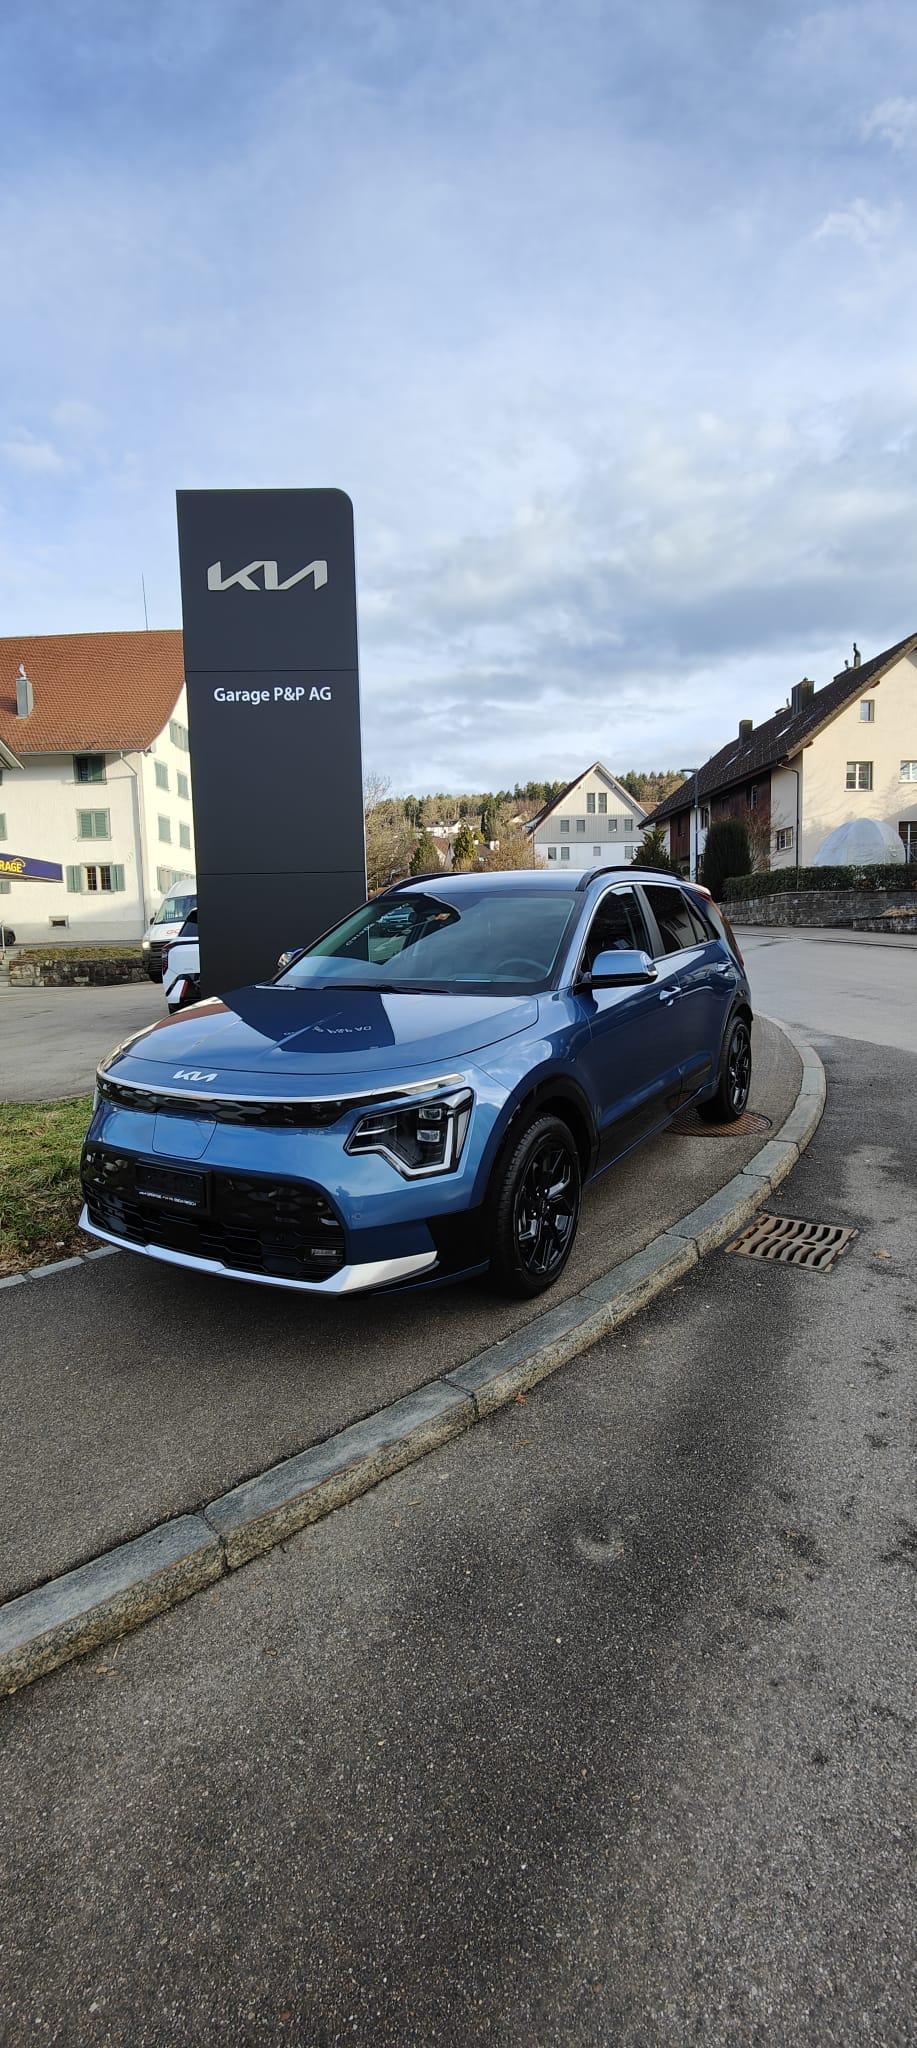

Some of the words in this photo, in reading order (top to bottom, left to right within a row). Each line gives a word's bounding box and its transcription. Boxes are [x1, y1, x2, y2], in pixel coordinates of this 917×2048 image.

[207, 560, 328, 591] KIA
[213, 687, 270, 705] Garage
[273, 687, 305, 701] P&P
[309, 686, 332, 701] AG
[172, 1069, 218, 1083] KIA
